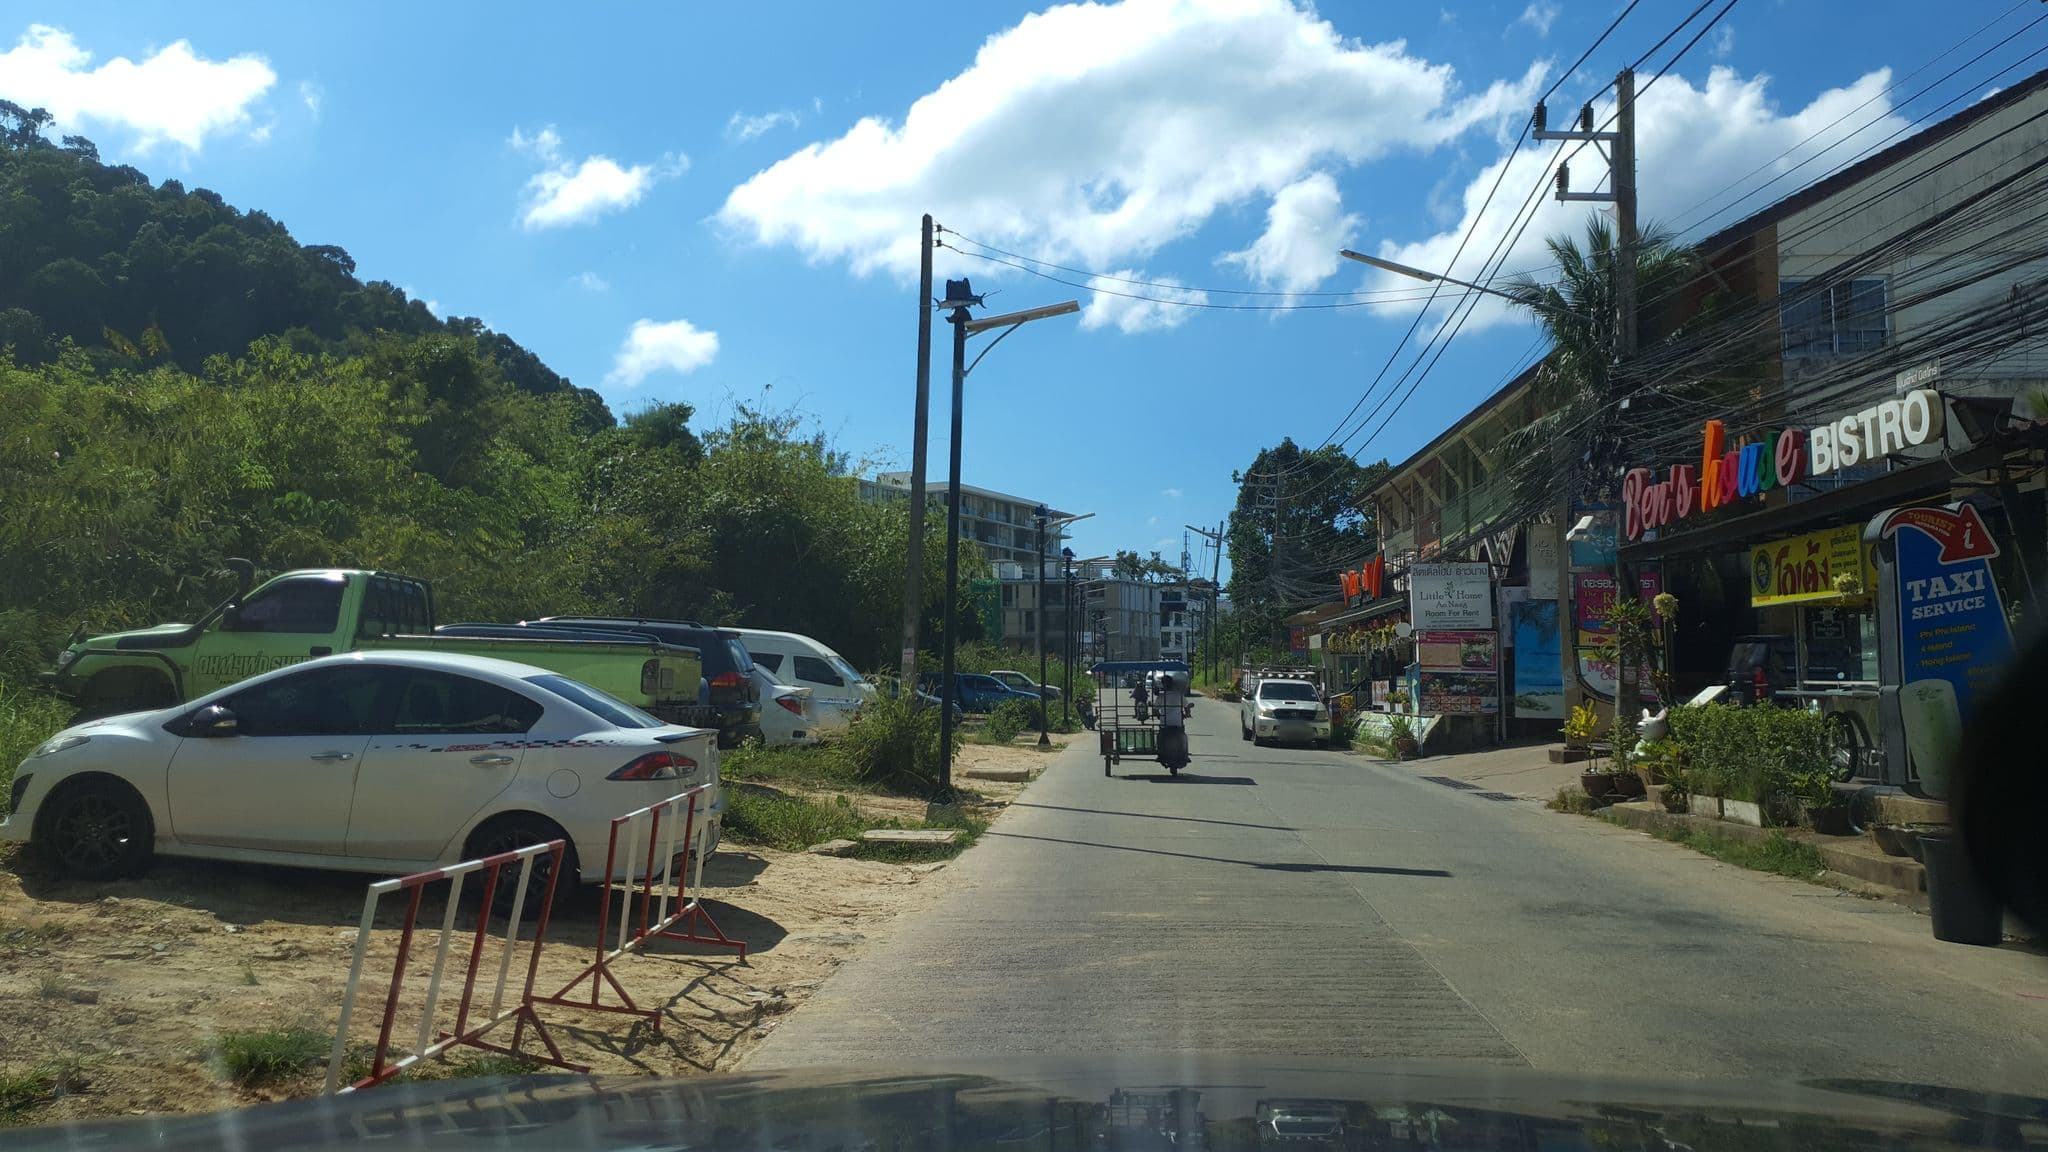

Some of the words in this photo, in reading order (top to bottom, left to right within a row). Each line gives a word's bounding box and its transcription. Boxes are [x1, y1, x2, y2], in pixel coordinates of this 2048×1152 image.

[1622, 463, 1697, 541] Ben's
[1701, 419, 1804, 513] house
[1810, 389, 1941, 476] BISTRO
[1908, 511, 1956, 532] TOURIST
[1420, 591, 1444, 601] Little
[1456, 590, 1483, 600] Home
[1906, 568, 1986, 602] TAXI
[1448, 609, 1460, 617] For
[1462, 609, 1480, 617] Rent
[1911, 595, 1986, 620] SERVICE
